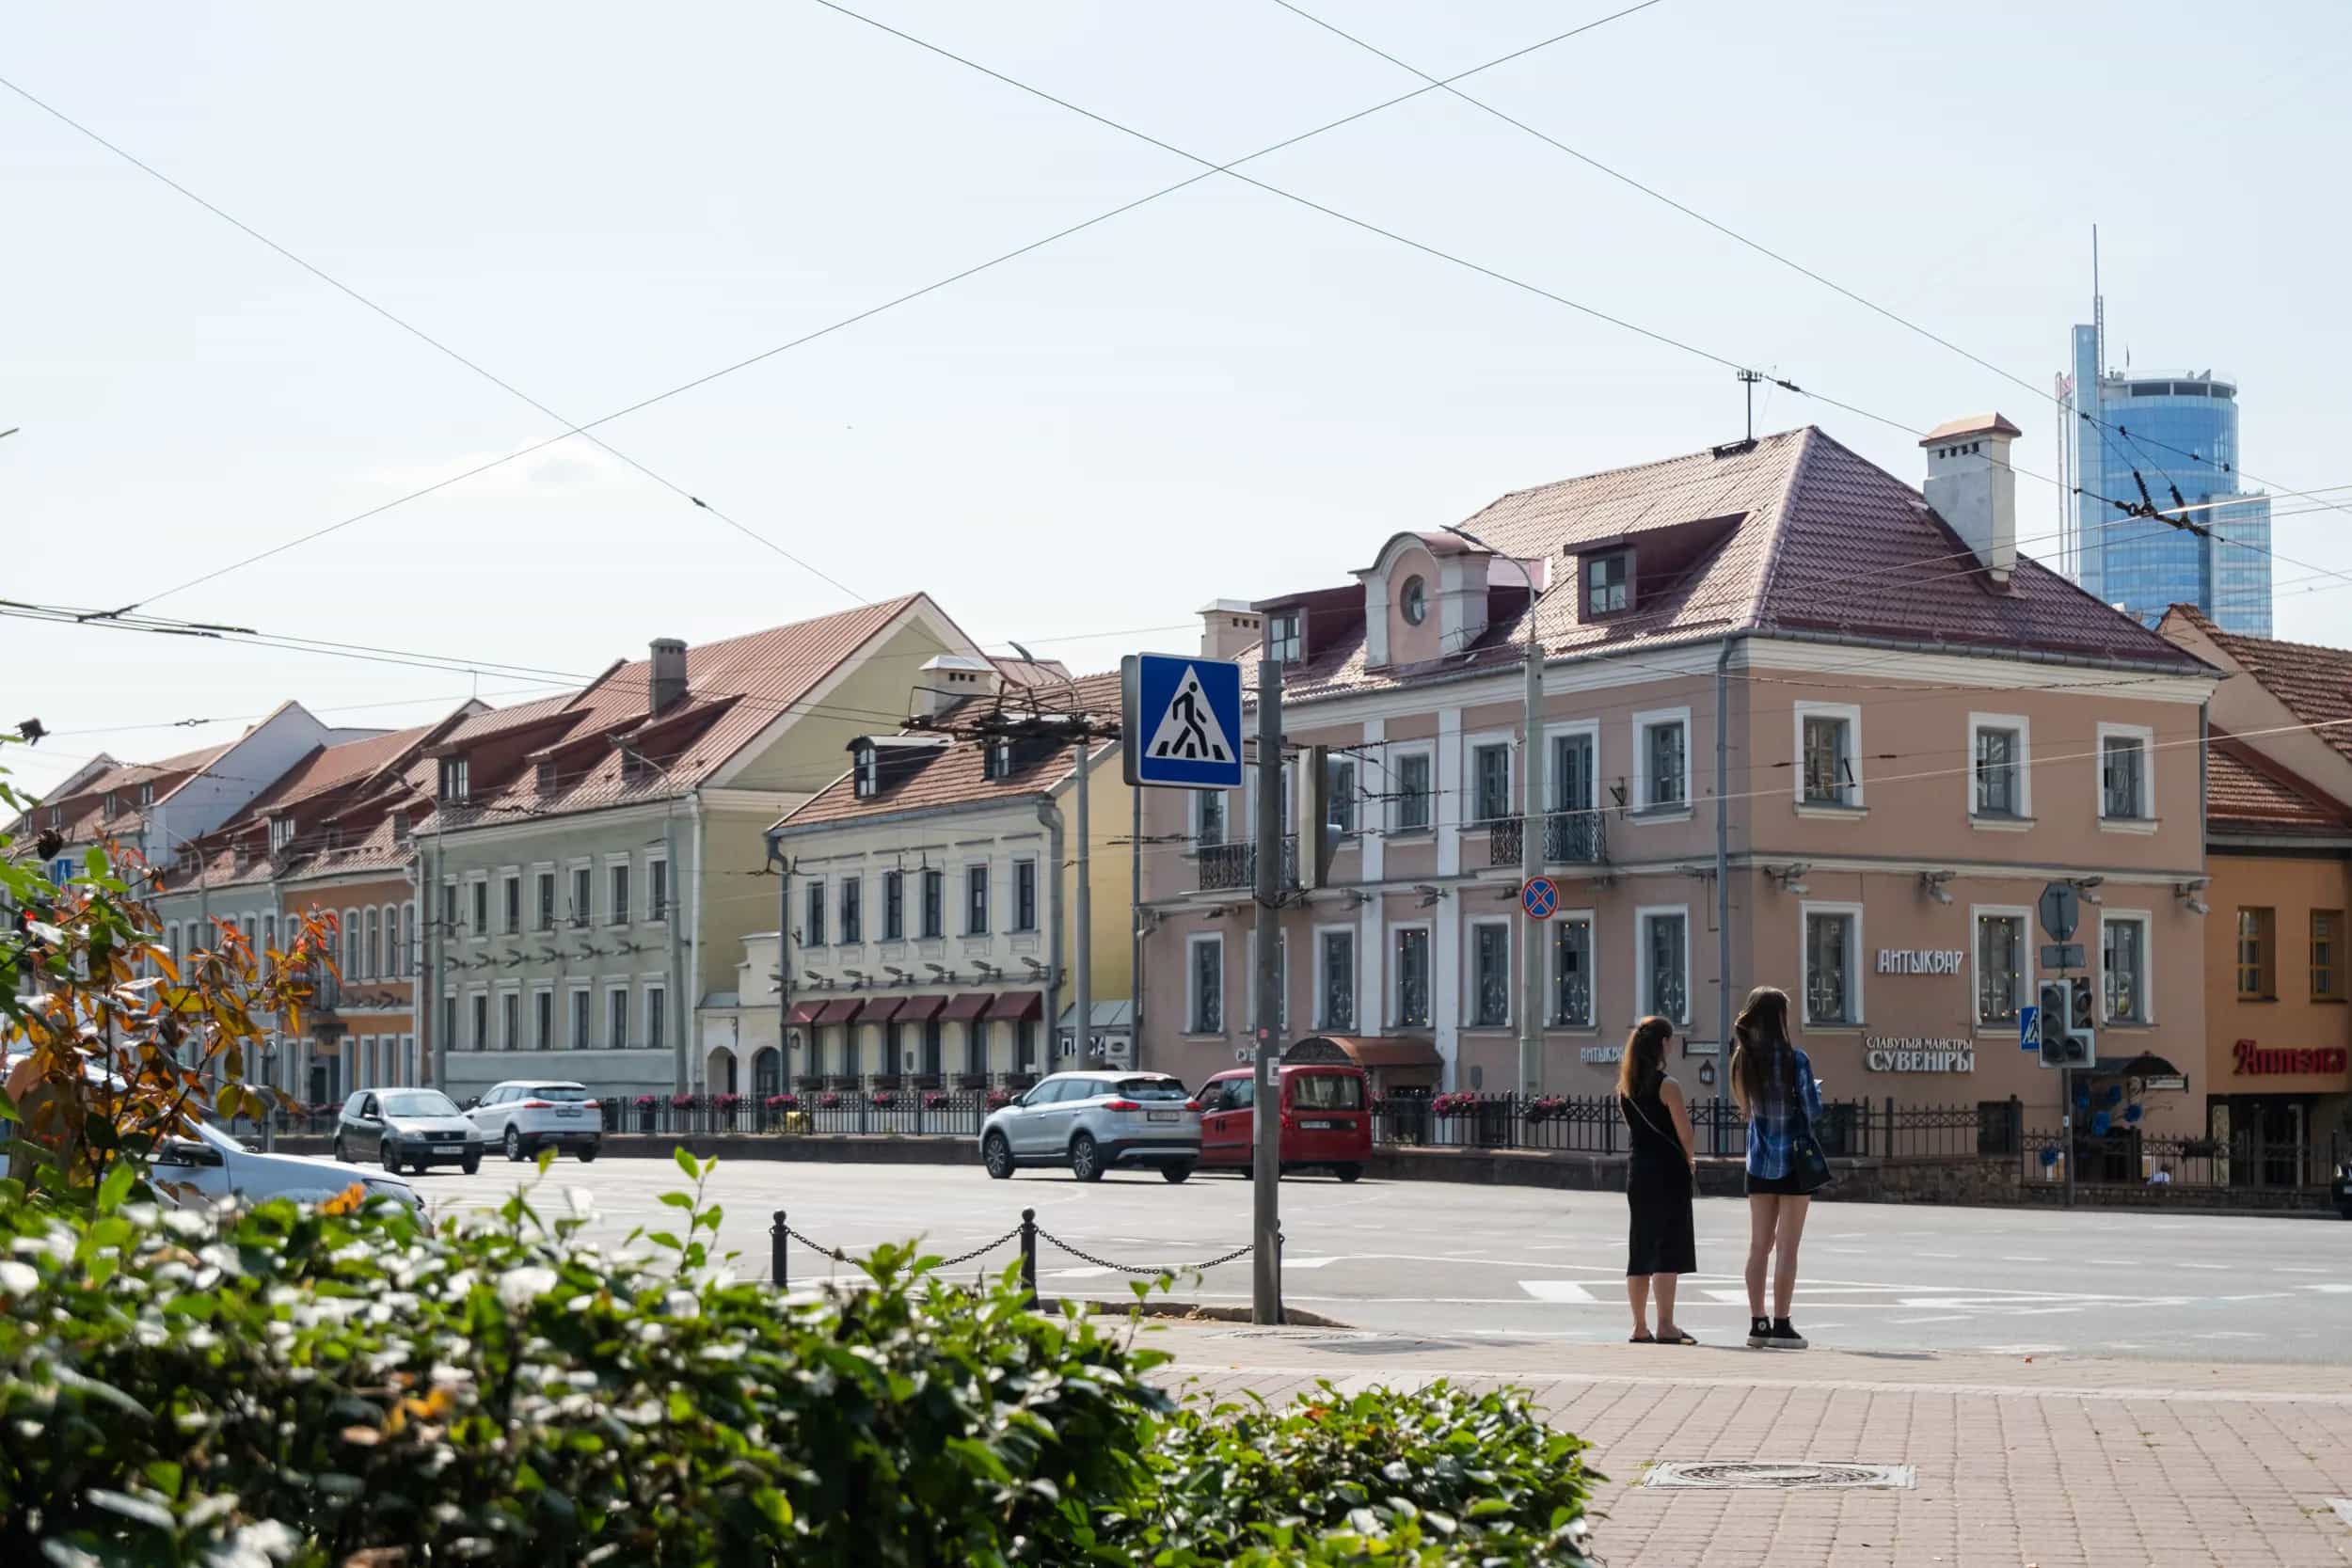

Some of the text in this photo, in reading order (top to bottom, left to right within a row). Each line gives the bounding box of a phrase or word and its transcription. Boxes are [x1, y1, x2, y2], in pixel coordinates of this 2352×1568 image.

[1877, 949, 1964, 974] АНТЫКВАР
[1866, 1037, 1922, 1049] СЛАВУТЫЯ
[1867, 1051, 1975, 1071] СУВЕНІРЫ
